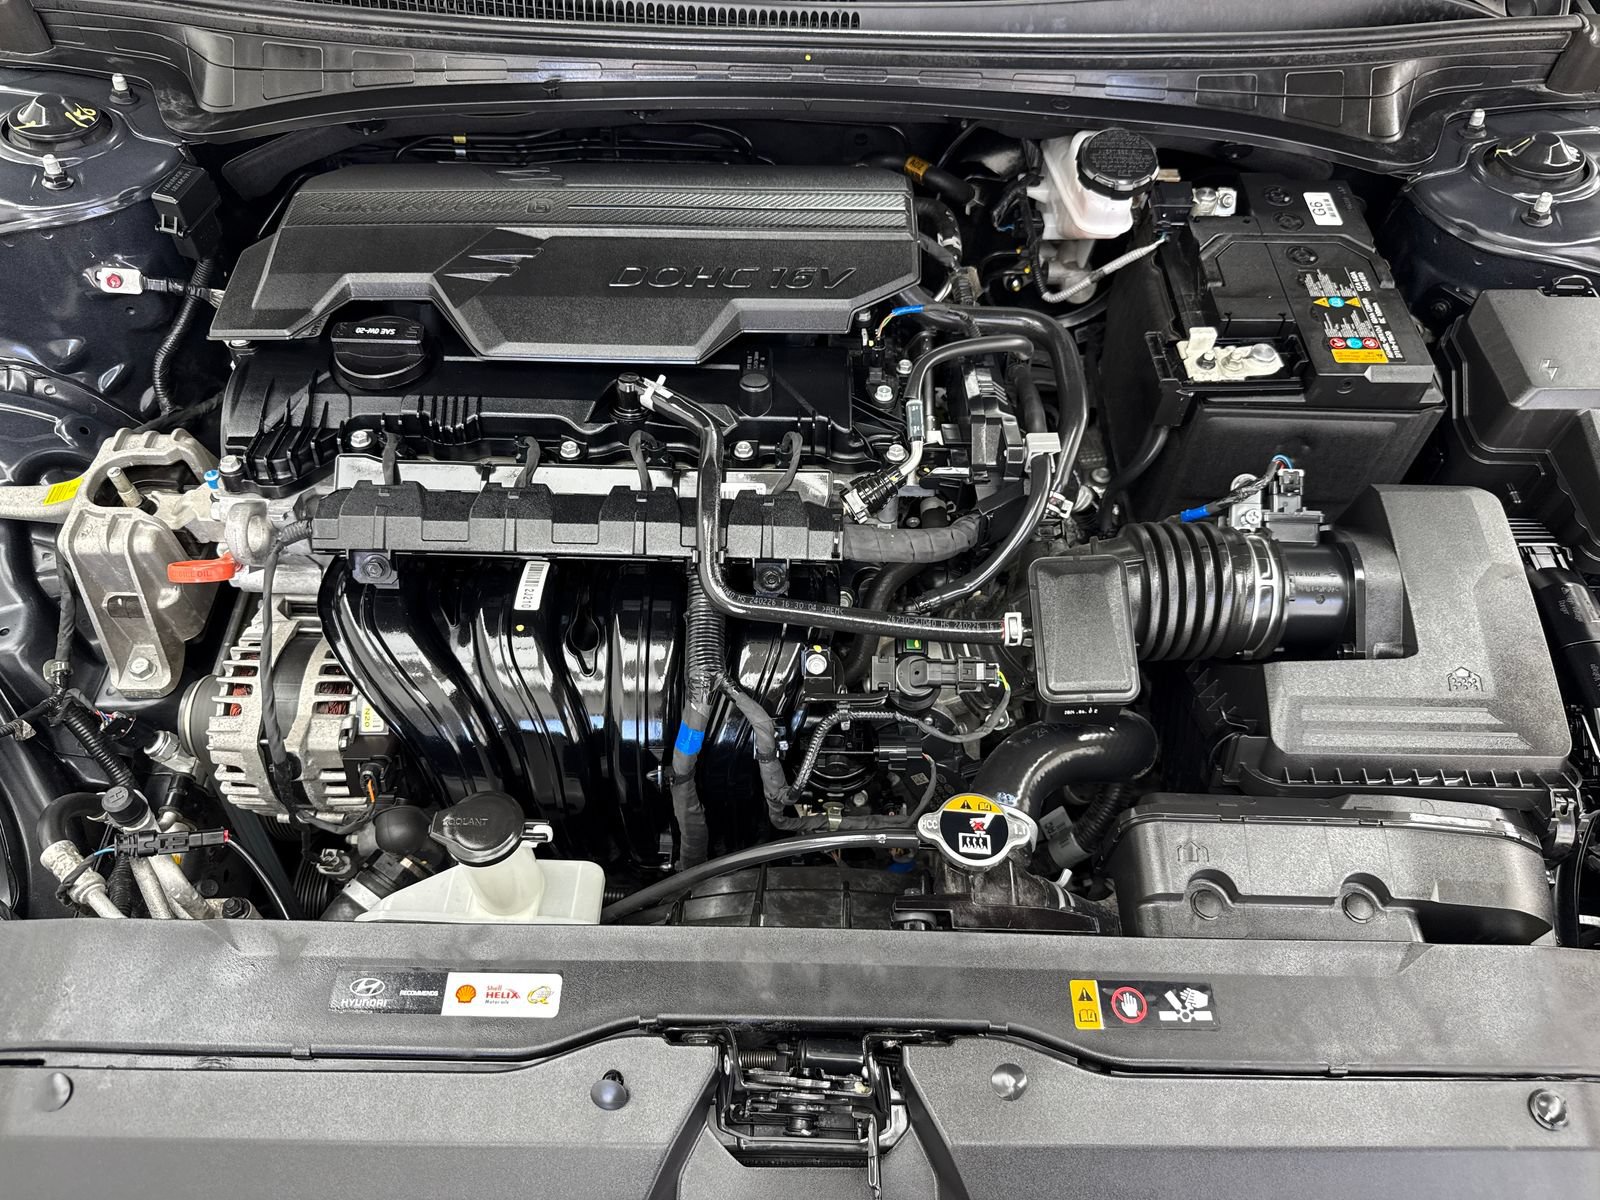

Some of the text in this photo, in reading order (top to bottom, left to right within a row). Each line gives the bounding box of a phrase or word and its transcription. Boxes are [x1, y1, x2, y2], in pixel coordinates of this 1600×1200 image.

[1309, 201, 1326, 216] G6
[608, 266, 857, 289] DOHC 16V
[355, 326, 397, 335] SAE 0W-20
[197, 570, 213, 578] OIL
[750, 597, 777, 607] 240226
[442, 816, 489, 827] COOLANT
[920, 819, 939, 830] HCC
[485, 991, 520, 999] HELIX
[341, 998, 388, 1008] HYUNDAI
